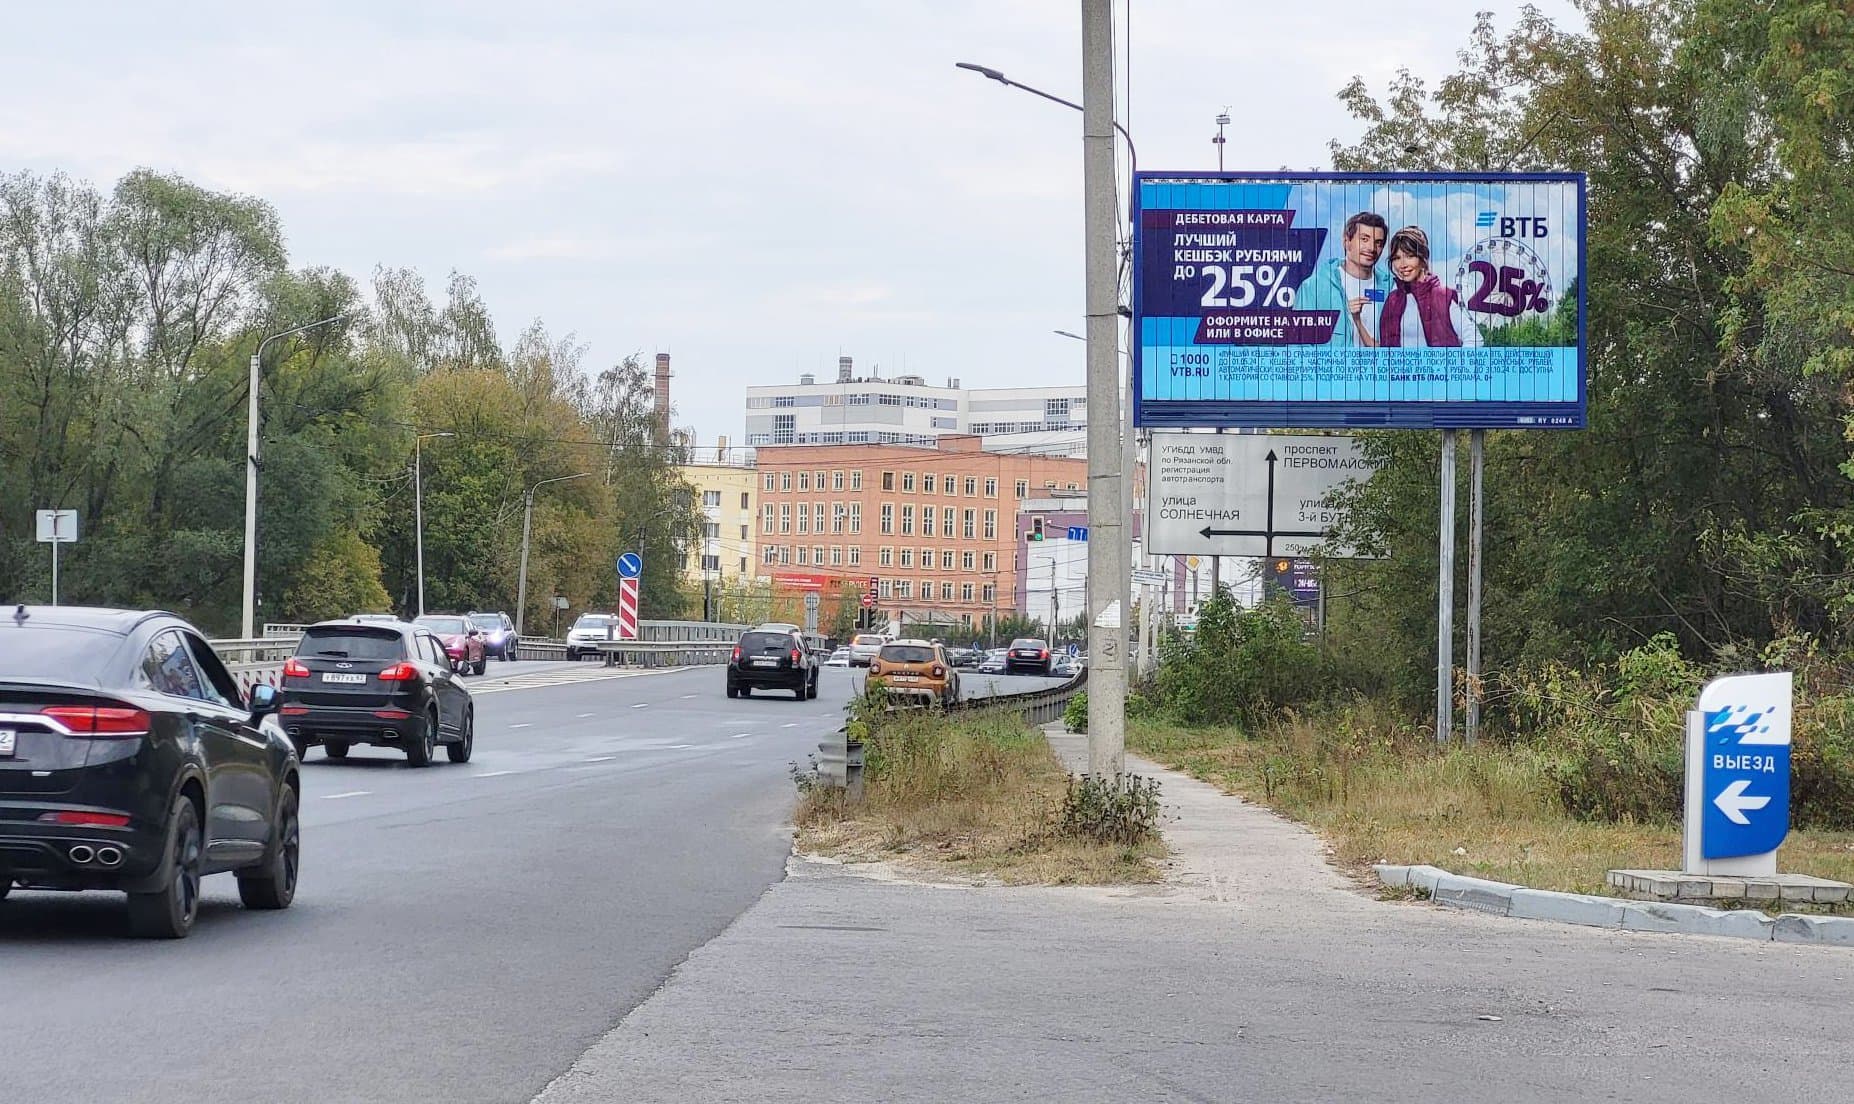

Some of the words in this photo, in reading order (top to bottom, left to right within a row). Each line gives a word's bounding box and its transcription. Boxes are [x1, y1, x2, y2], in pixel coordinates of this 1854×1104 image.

[1175, 214, 1244, 225] ДЕБЕТОВАЯ
[1247, 214, 1285, 224] КАРТА
[1500, 217, 1548, 238] ВТБ
[1174, 231, 1236, 247] ЛУЧШИЙ
[1174, 250, 1232, 263] КЕШБЭК
[1235, 250, 1302, 263] РУБЛЯМИ
[1174, 265, 1195, 280] ДО
[1201, 265, 1296, 308] 25%
[1468, 260, 1549, 317] 25%
[1206, 316, 1271, 326] ОФОРМИТЕ
[1273, 316, 1289, 326] НА
[1292, 316, 1332, 327] VTB.RU
[1206, 328, 1230, 338] ИЛИ
[1234, 328, 1241, 338] В
[1244, 328, 1284, 338] ОФИСЕ
[1181, 354, 1209, 364] 1000
[1171, 367, 1209, 377] VTB.RU
[1200, 446, 1224, 455] УМВД
[1284, 445, 1337, 457] проспект
[1173, 456, 1214, 465] Рязанской
[1216, 457, 1233, 465] обл.
[1161, 467, 1210, 475] регистрация
[1161, 475, 1224, 484] автотранспорта
[1161, 496, 1197, 507] улица
[1299, 499, 1335, 510] улица
[1160, 508, 1240, 521] СОЛНЕЧНАЯ
[1285, 543, 1300, 551] 250
[1713, 754, 1775, 773] ВЫЕЗД
